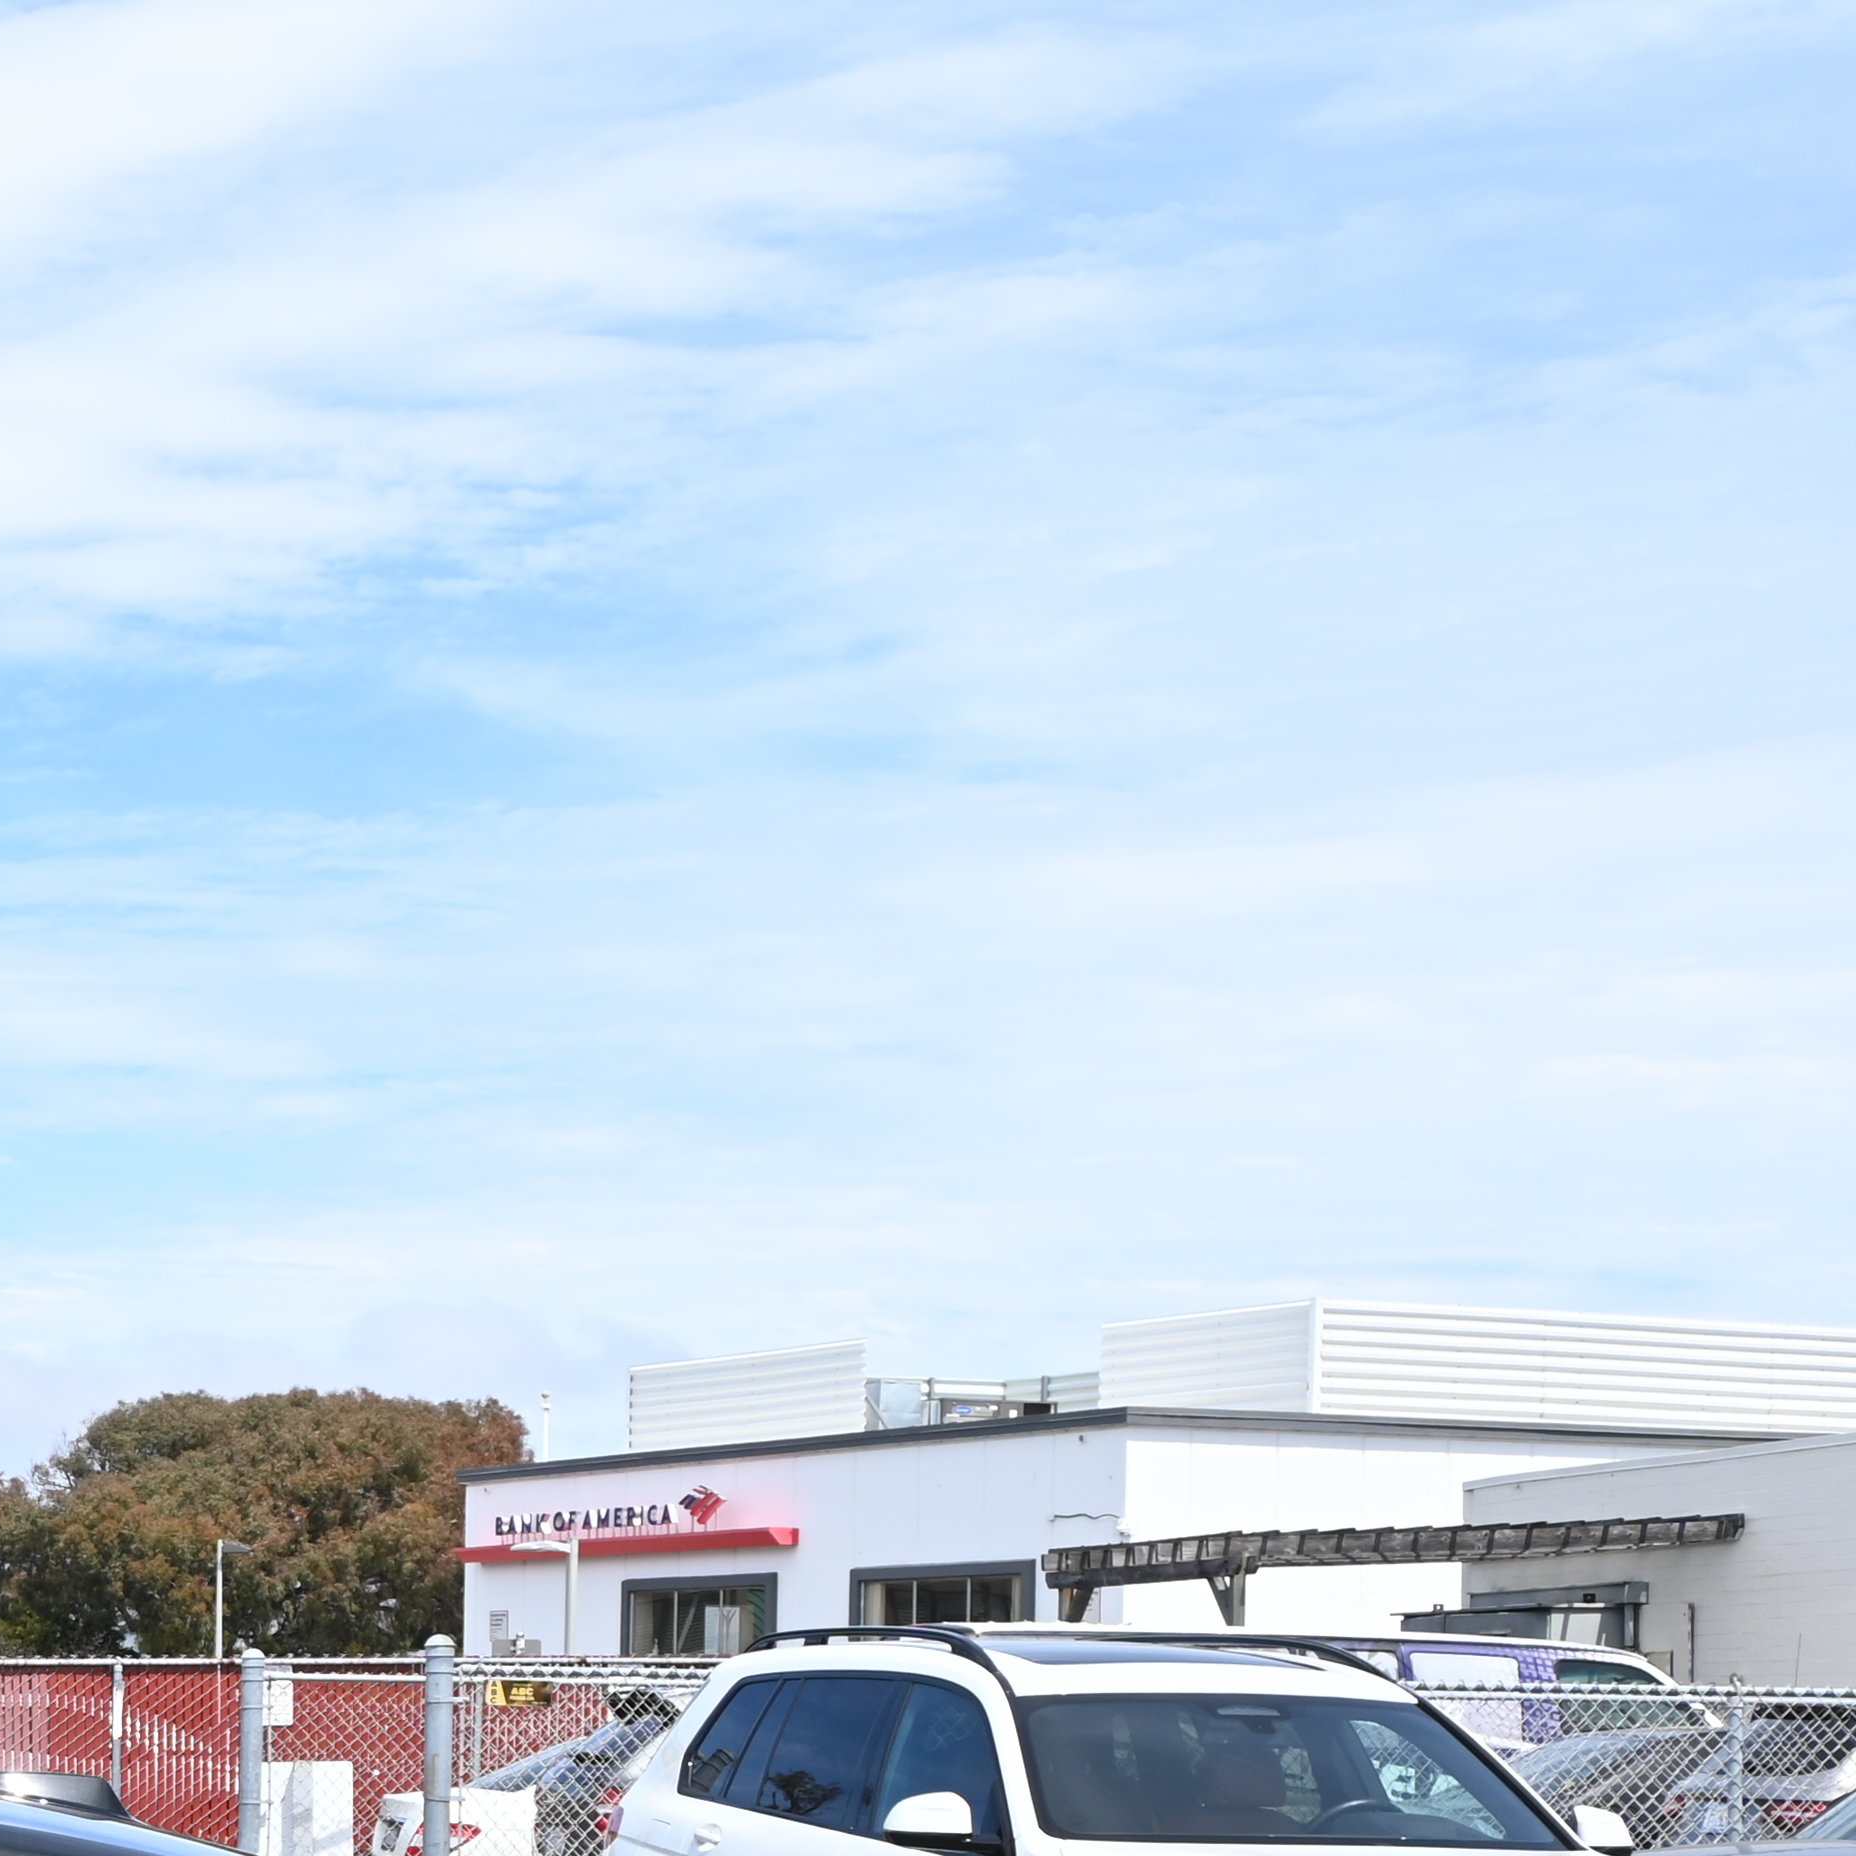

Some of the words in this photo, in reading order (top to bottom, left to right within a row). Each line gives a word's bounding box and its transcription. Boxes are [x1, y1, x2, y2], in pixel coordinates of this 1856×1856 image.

[495, 1512, 551, 1535] BANK
[552, 1510, 580, 1532] OF
[582, 1503, 679, 1530] AMERICA
[511, 1687, 534, 1696] ABC
